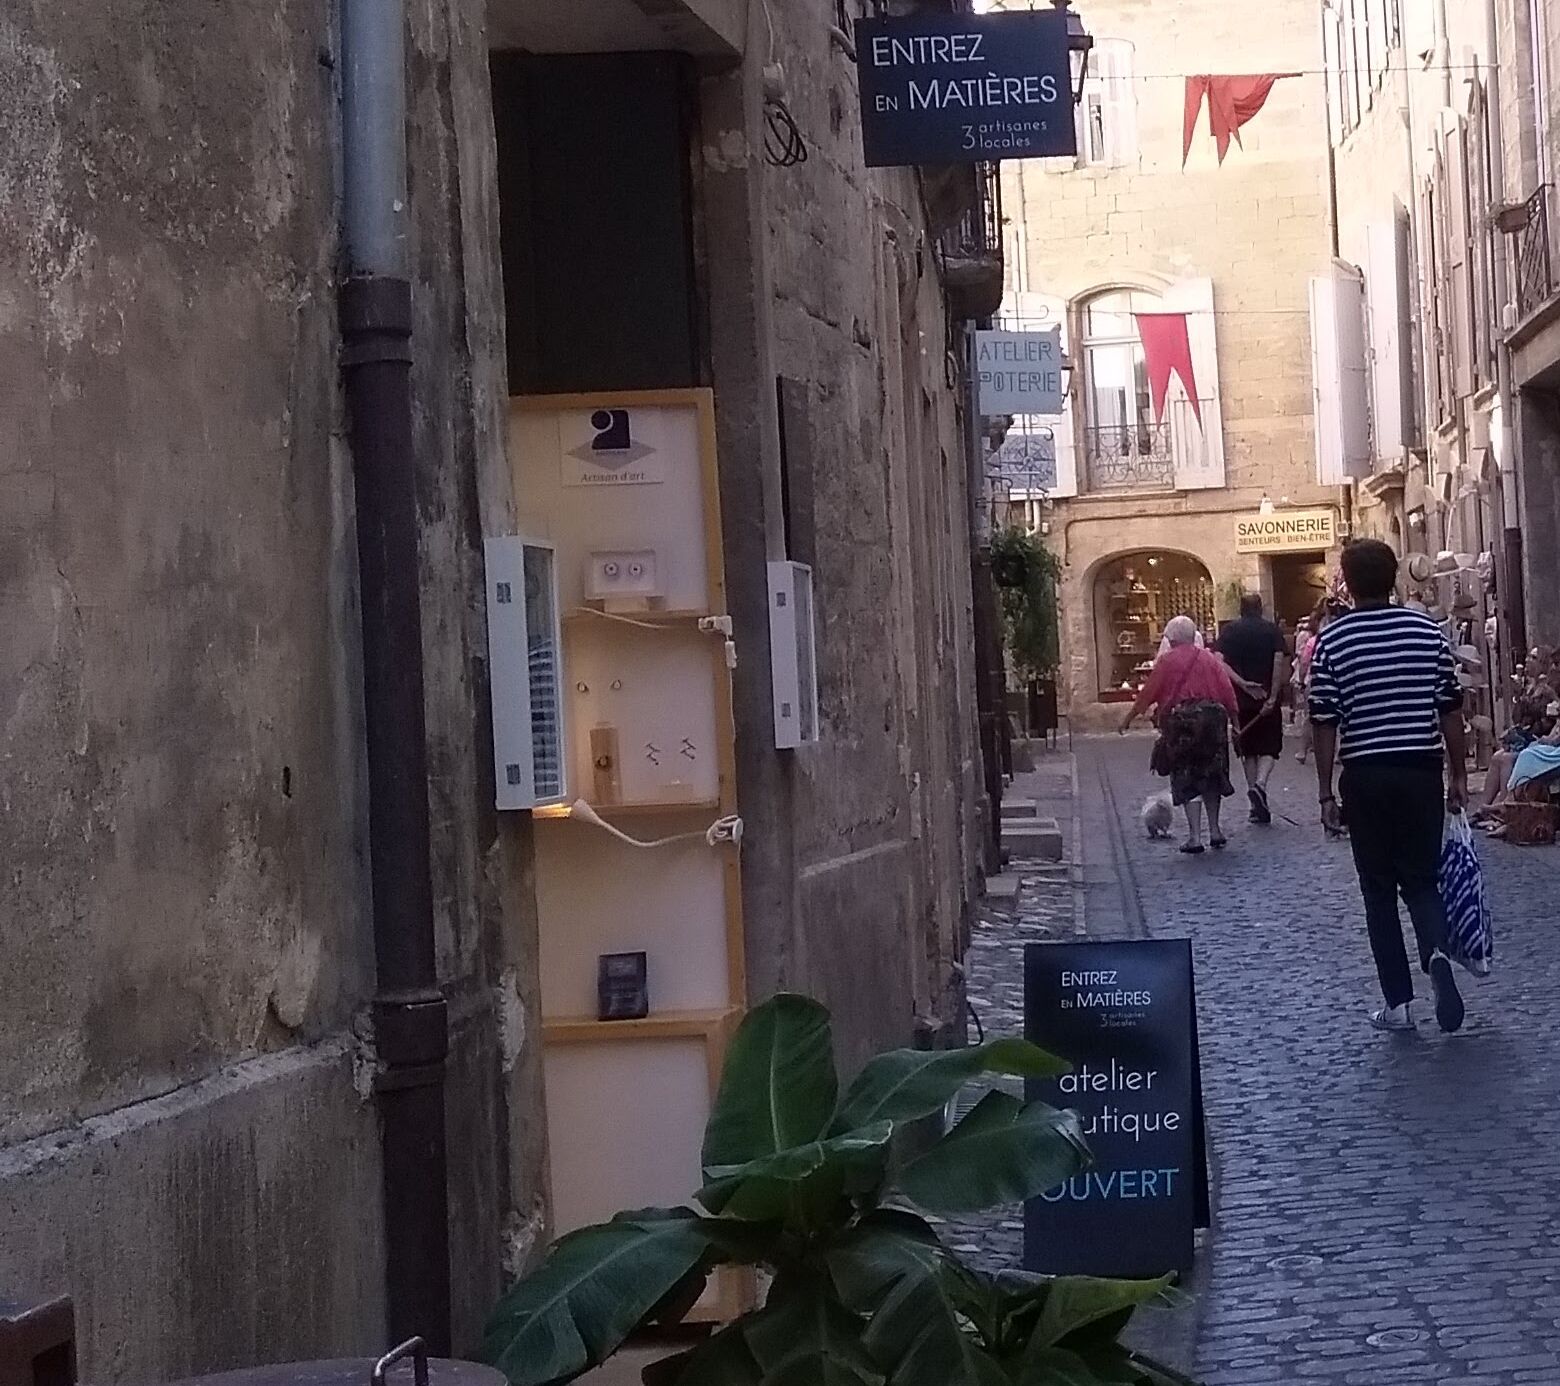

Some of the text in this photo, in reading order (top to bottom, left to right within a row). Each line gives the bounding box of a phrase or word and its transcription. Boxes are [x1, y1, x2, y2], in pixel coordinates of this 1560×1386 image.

[872, 34, 985, 66] ENTREZ
[875, 71, 1057, 112] EN MATIÈRES
[961, 119, 1047, 149] 3 artisanes
[979, 133, 1031, 149] locales
[980, 340, 1052, 362] ATELIER
[979, 369, 1056, 392] POTERIE
[1238, 517, 1330, 536] SAVONNERIE
[1238, 536, 1280, 546] SENTEURS
[1062, 971, 1117, 987] ENTREZ
[1061, 989, 1151, 1009] EN MATIÈRES
[1059, 1057, 1157, 1093] atelier
[1081, 1105, 1180, 1142] utique
